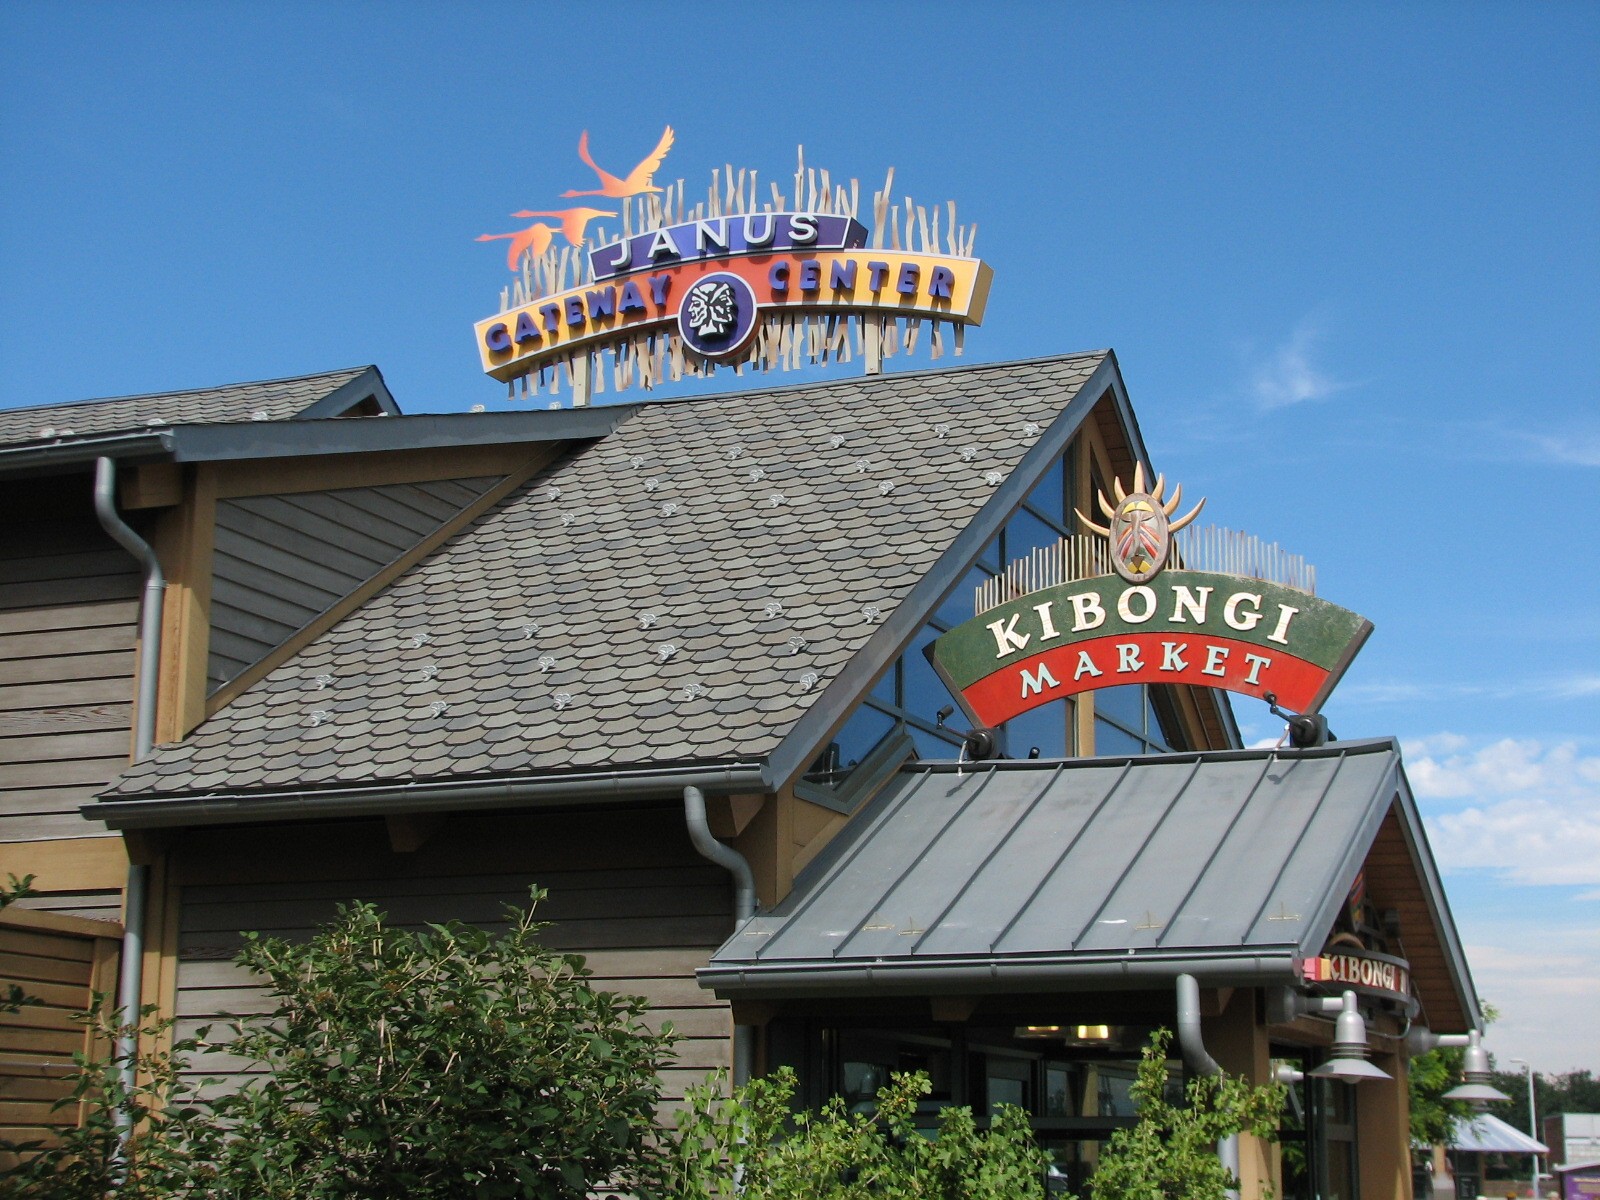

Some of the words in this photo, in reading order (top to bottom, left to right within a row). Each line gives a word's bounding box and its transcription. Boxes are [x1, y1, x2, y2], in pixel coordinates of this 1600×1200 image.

[609, 214, 818, 267] JANUS
[484, 274, 672, 352] GATEWAY
[768, 257, 955, 300] CENTER
[985, 586, 1300, 658] KIBONGI
[1021, 641, 1272, 698] MARKET
